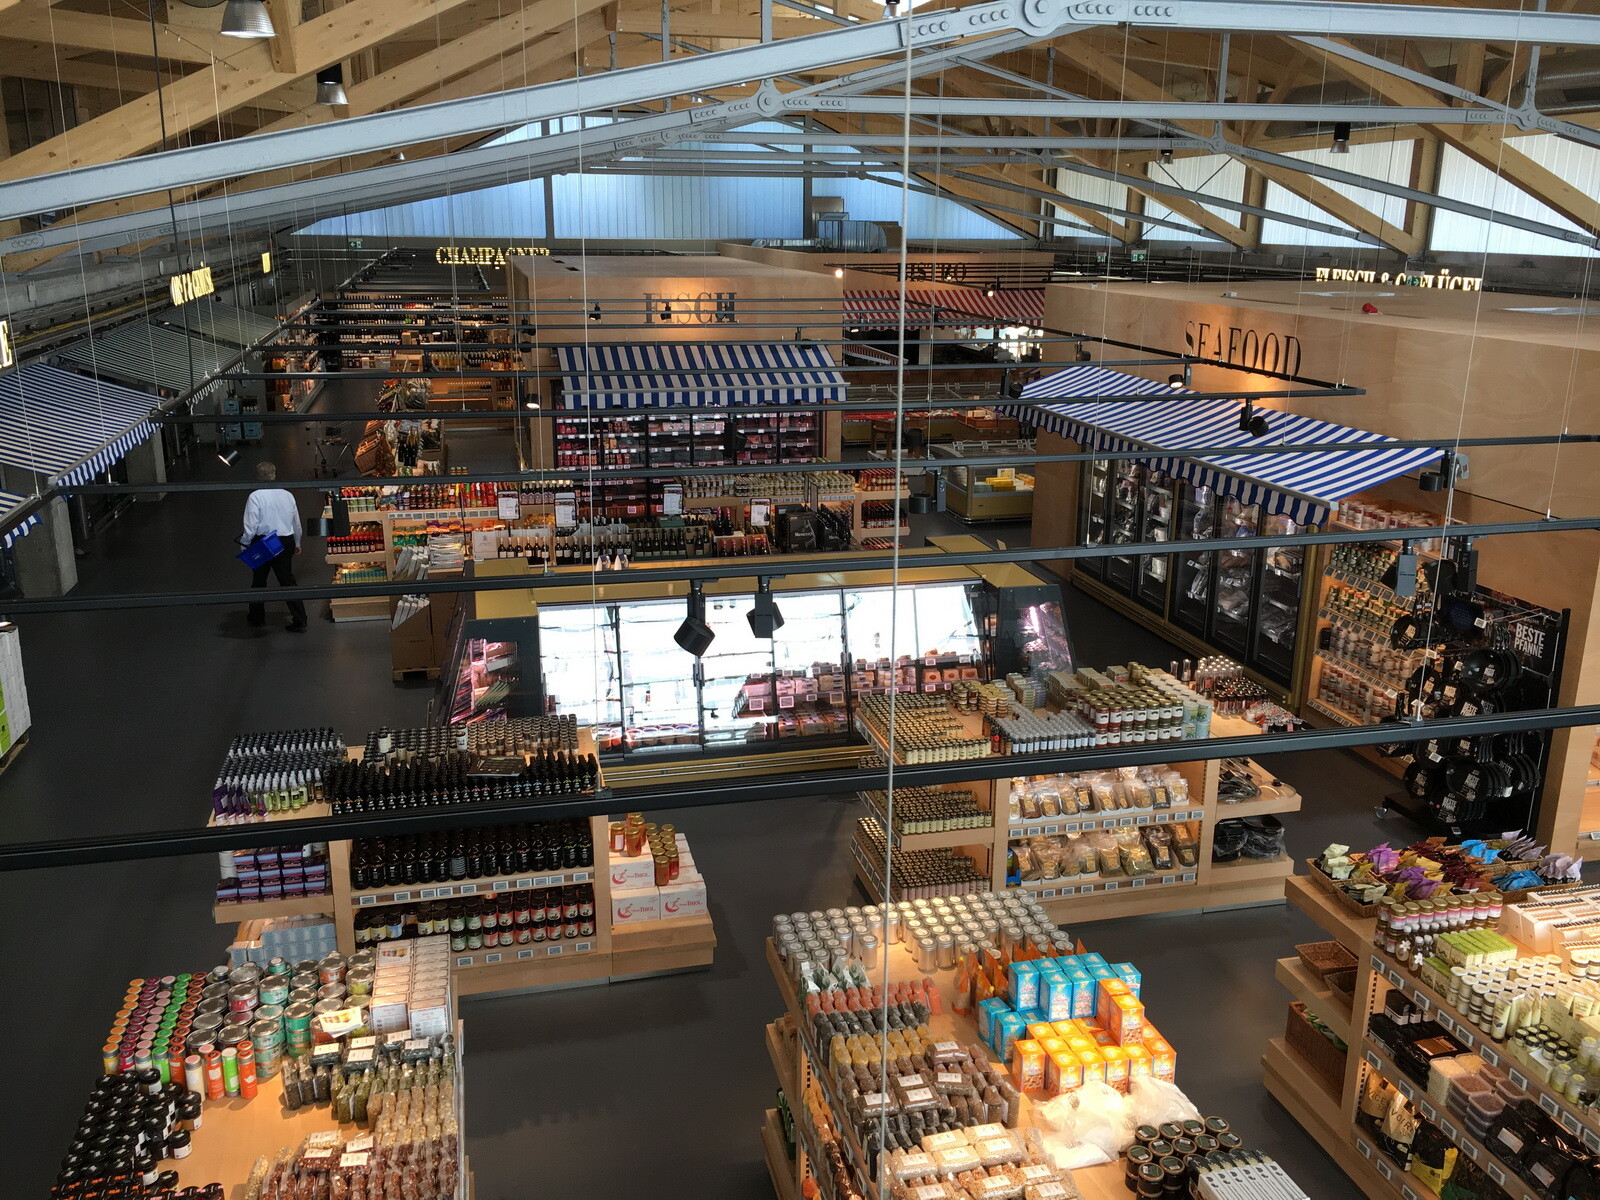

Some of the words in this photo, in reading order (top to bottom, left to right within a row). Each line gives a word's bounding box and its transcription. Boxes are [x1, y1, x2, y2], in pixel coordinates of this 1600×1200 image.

[1185, 320, 1301, 378] SEAFOOD
[1515, 622, 1546, 647] BESTE
[1513, 637, 1544, 659] PFANNE
